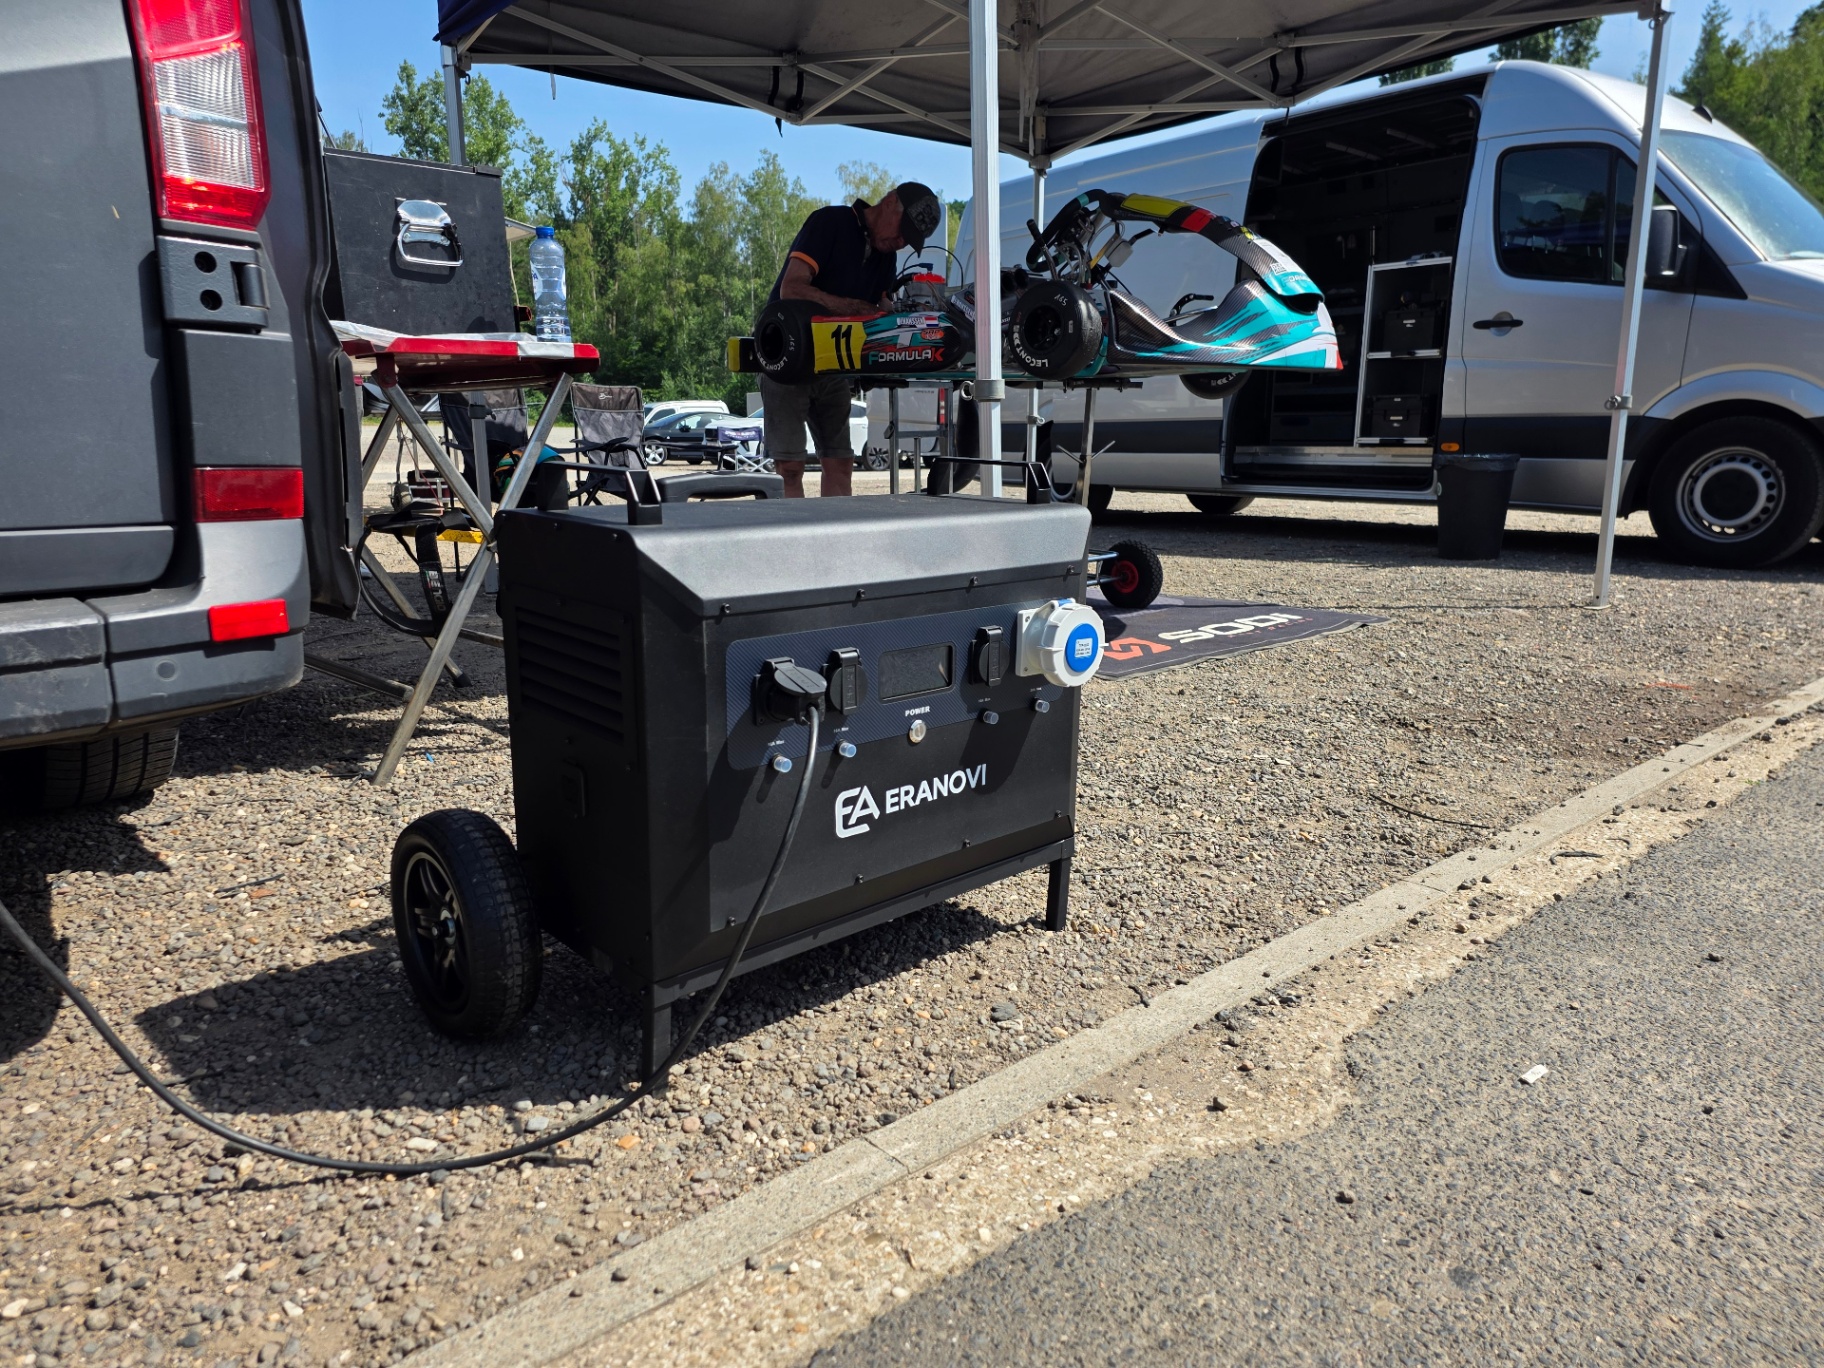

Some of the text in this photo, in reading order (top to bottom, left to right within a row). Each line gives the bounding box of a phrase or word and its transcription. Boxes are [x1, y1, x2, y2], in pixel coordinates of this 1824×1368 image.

[831, 324, 856, 370] 11
[1016, 346, 1049, 368] LECONT
[905, 706, 930, 717] POWER
[886, 763, 987, 813] ERANOVI
